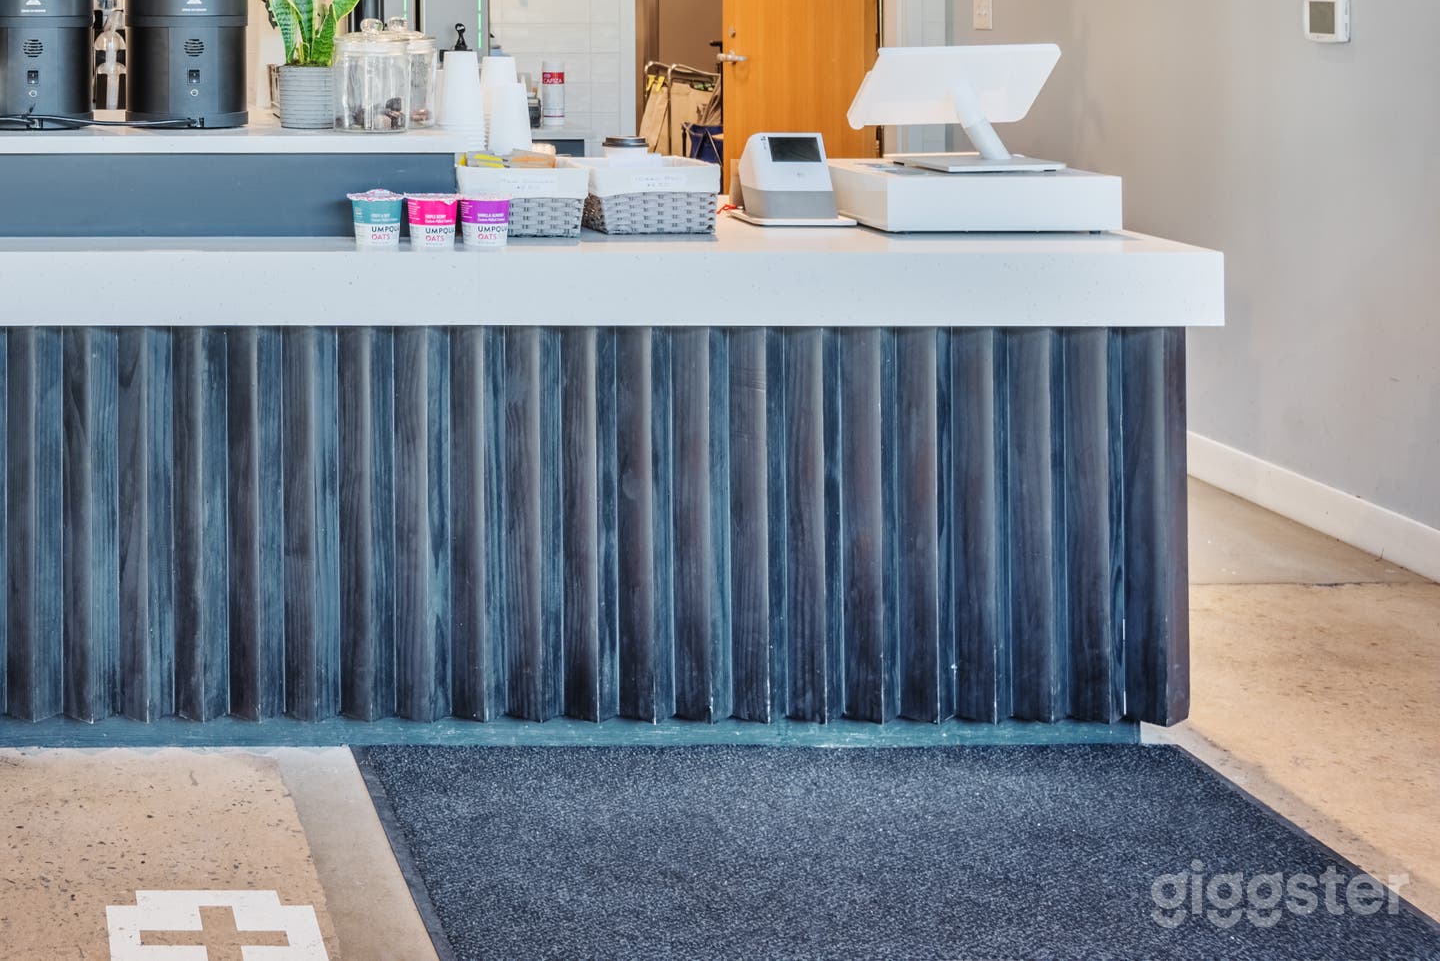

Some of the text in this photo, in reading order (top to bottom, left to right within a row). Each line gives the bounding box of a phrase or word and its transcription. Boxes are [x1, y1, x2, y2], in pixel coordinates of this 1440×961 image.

[371, 233, 391, 241] OATS
[425, 235, 445, 243] OATS
[477, 233, 497, 241] OATS
